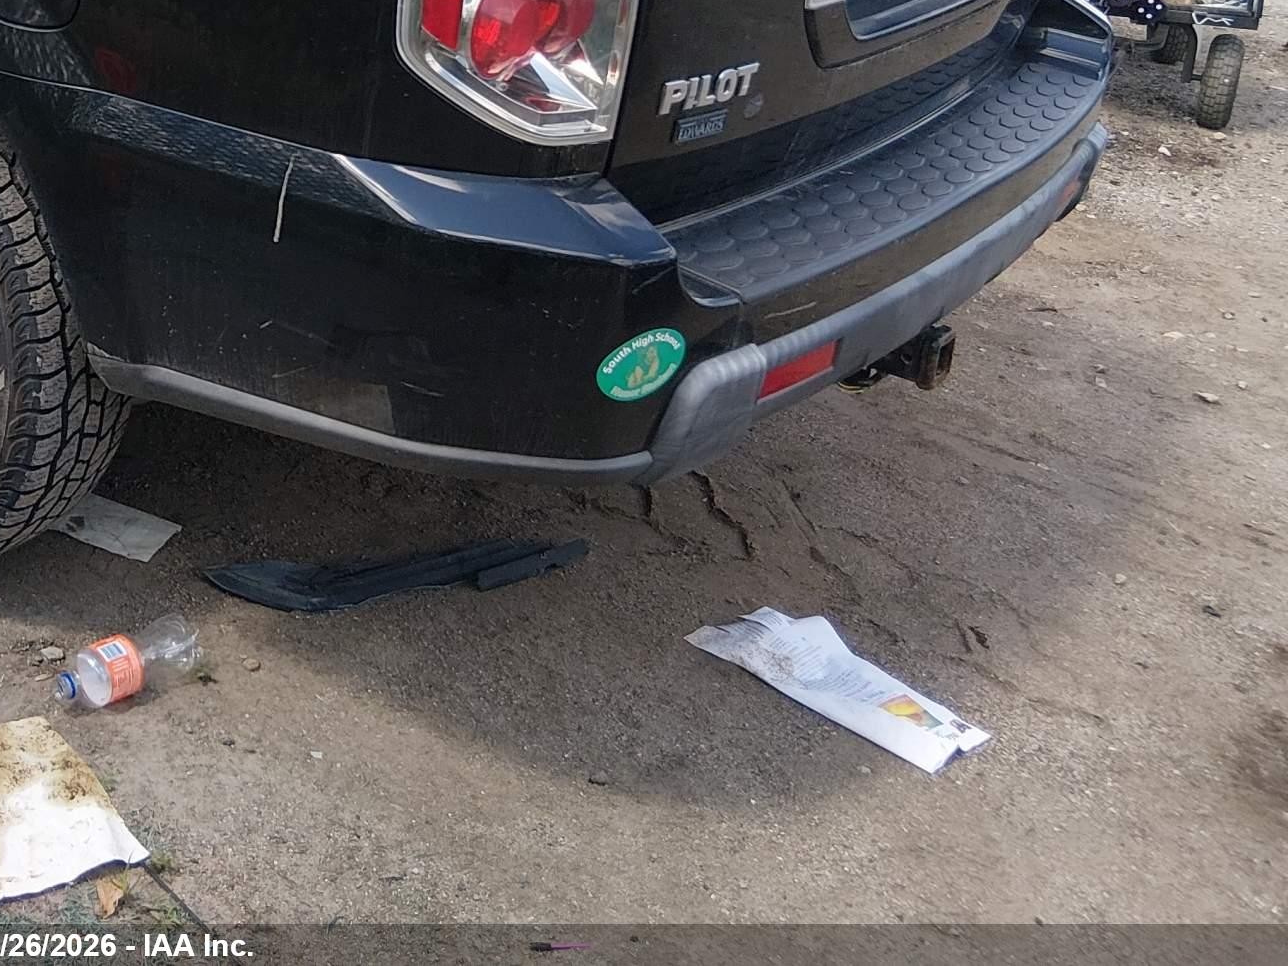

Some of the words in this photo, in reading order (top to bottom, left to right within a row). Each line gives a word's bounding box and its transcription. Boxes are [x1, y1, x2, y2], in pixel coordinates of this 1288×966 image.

[657, 62, 760, 115] PILOT
[602, 346, 632, 374] South
[631, 335, 655, 350] High
[655, 332, 681, 351] School
